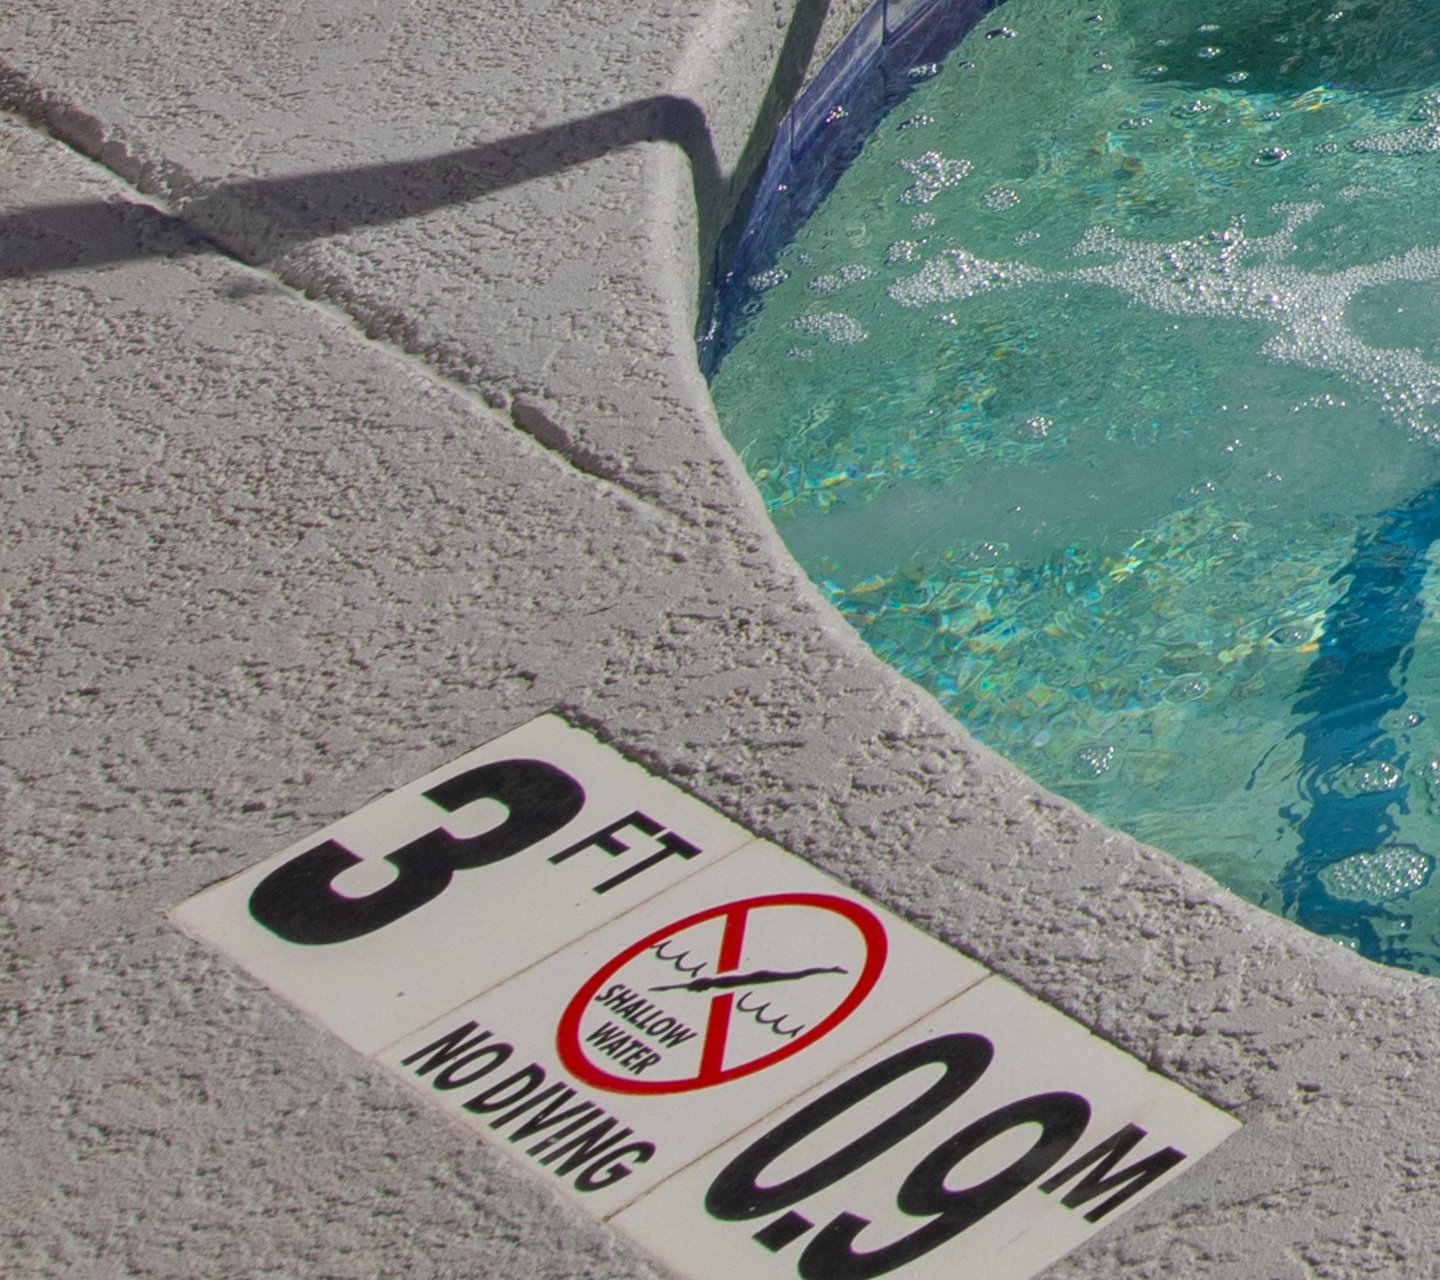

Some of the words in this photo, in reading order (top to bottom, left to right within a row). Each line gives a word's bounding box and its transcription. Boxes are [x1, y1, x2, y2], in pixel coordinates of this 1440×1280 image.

[247, 758, 586, 945] 3
[547, 810, 703, 895] FT
[585, 1021, 662, 1075] WATER
[594, 983, 698, 1049] SHALLOW
[400, 1019, 515, 1090] NO
[460, 1062, 656, 1193] DIVING
[704, 1032, 1092, 1280] 0.9
[1038, 1123, 1188, 1223] M
